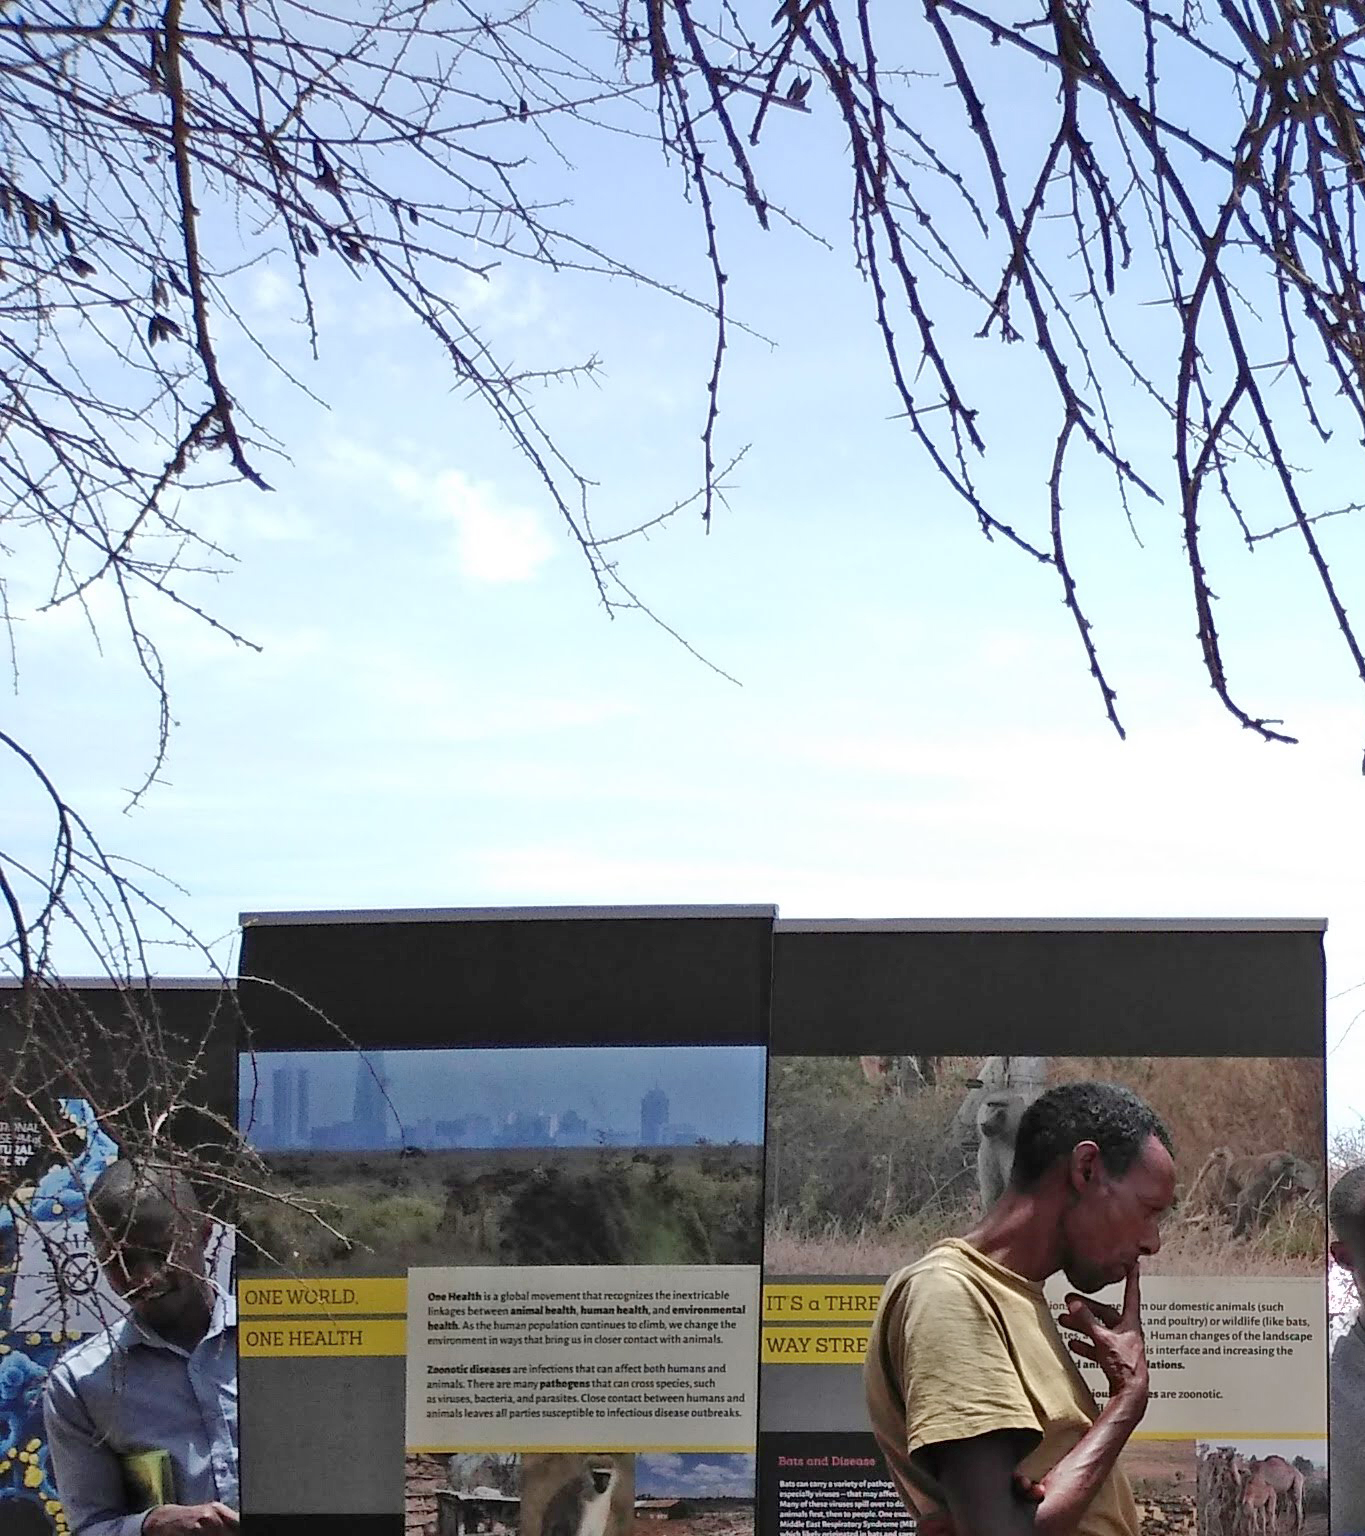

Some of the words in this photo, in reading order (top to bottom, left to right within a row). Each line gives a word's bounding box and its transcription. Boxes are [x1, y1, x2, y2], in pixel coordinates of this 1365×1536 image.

[824, 1295, 880, 1310] THRE
[245, 1331, 283, 1346] ONE
[288, 1330, 363, 1345] HEALTH
[1150, 1331, 1187, 1339] Human
[1189, 1330, 1230, 1342] changes
[1231, 1330, 1242, 1340] of
[1243, 1330, 1260, 1340] the
[1262, 1331, 1313, 1342] landscape
[815, 1337, 868, 1352] STRE
[778, 1456, 804, 1465] Bats
[805, 1456, 828, 1465] and
[831, 1456, 876, 1466] Disease
